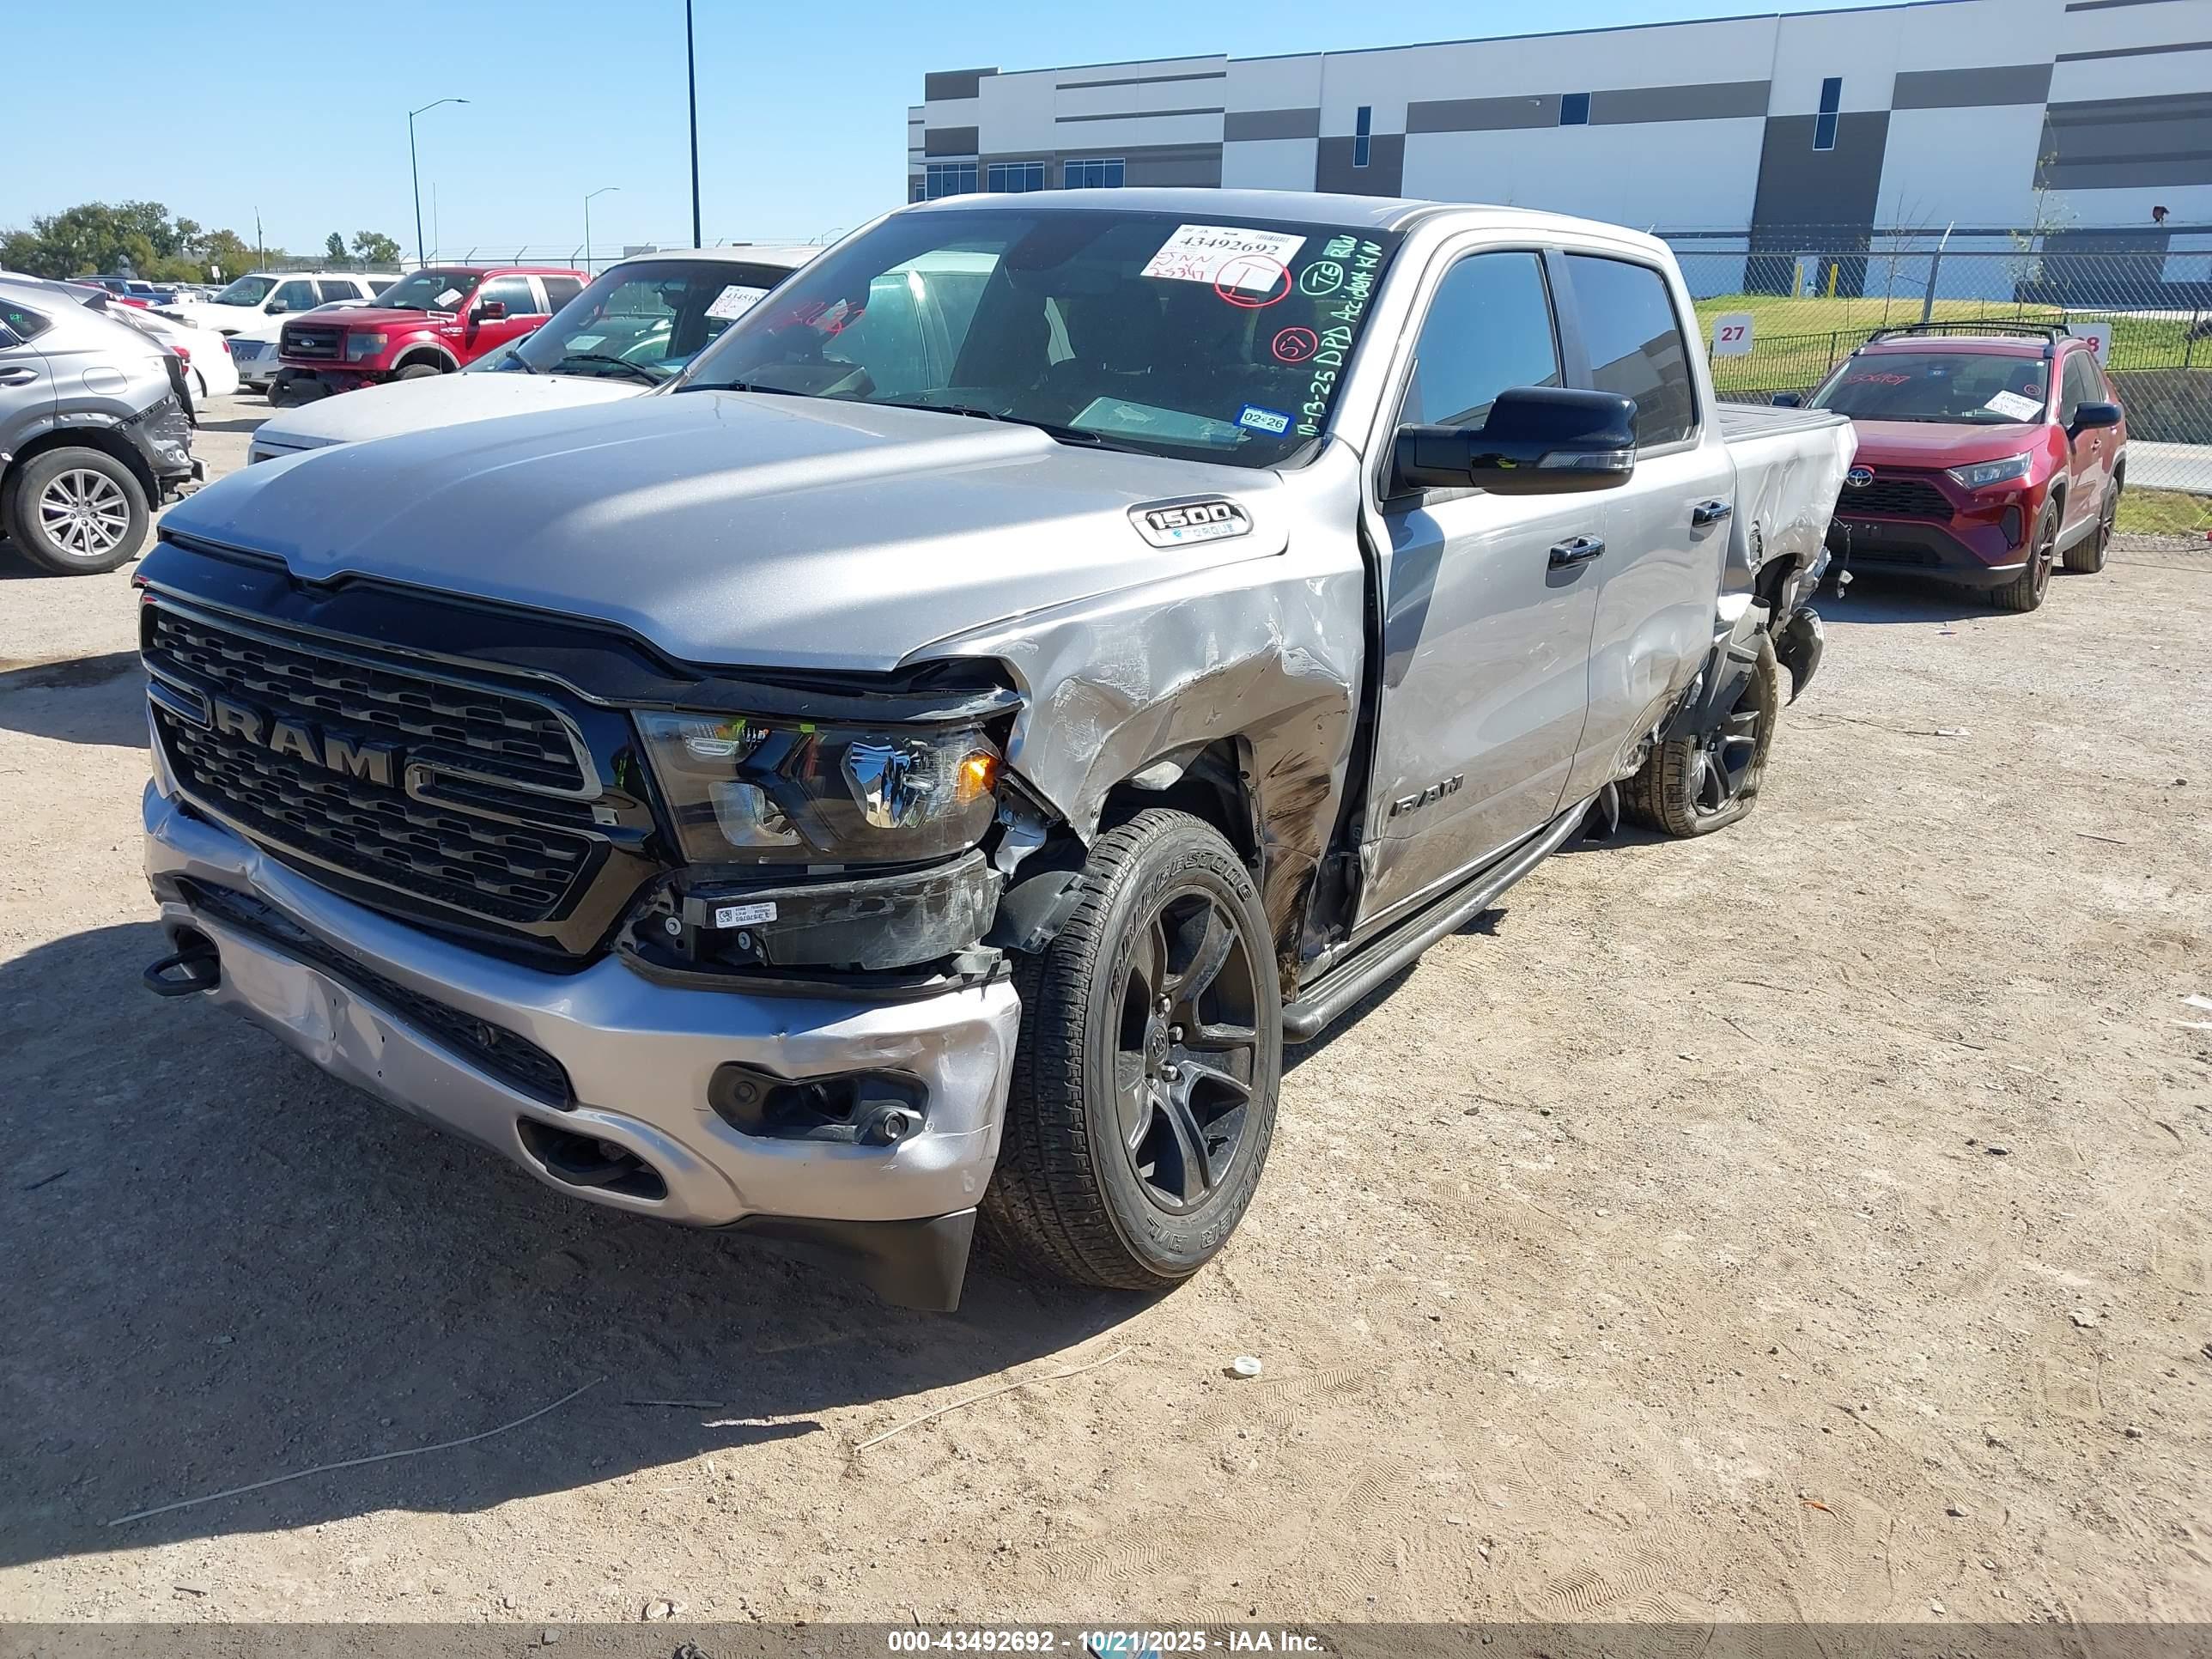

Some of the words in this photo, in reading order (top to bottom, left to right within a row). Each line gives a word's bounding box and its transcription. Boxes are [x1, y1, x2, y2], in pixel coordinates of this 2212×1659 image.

[1180, 236, 1280, 256] 43492692
[1721, 326, 1745, 341] 27
[1243, 411, 1261, 423] 02
[1266, 417, 1285, 429] 26
[1146, 503, 1232, 530] 1500
[215, 697, 400, 788] RAM
[1389, 773, 1464, 817] RAM
